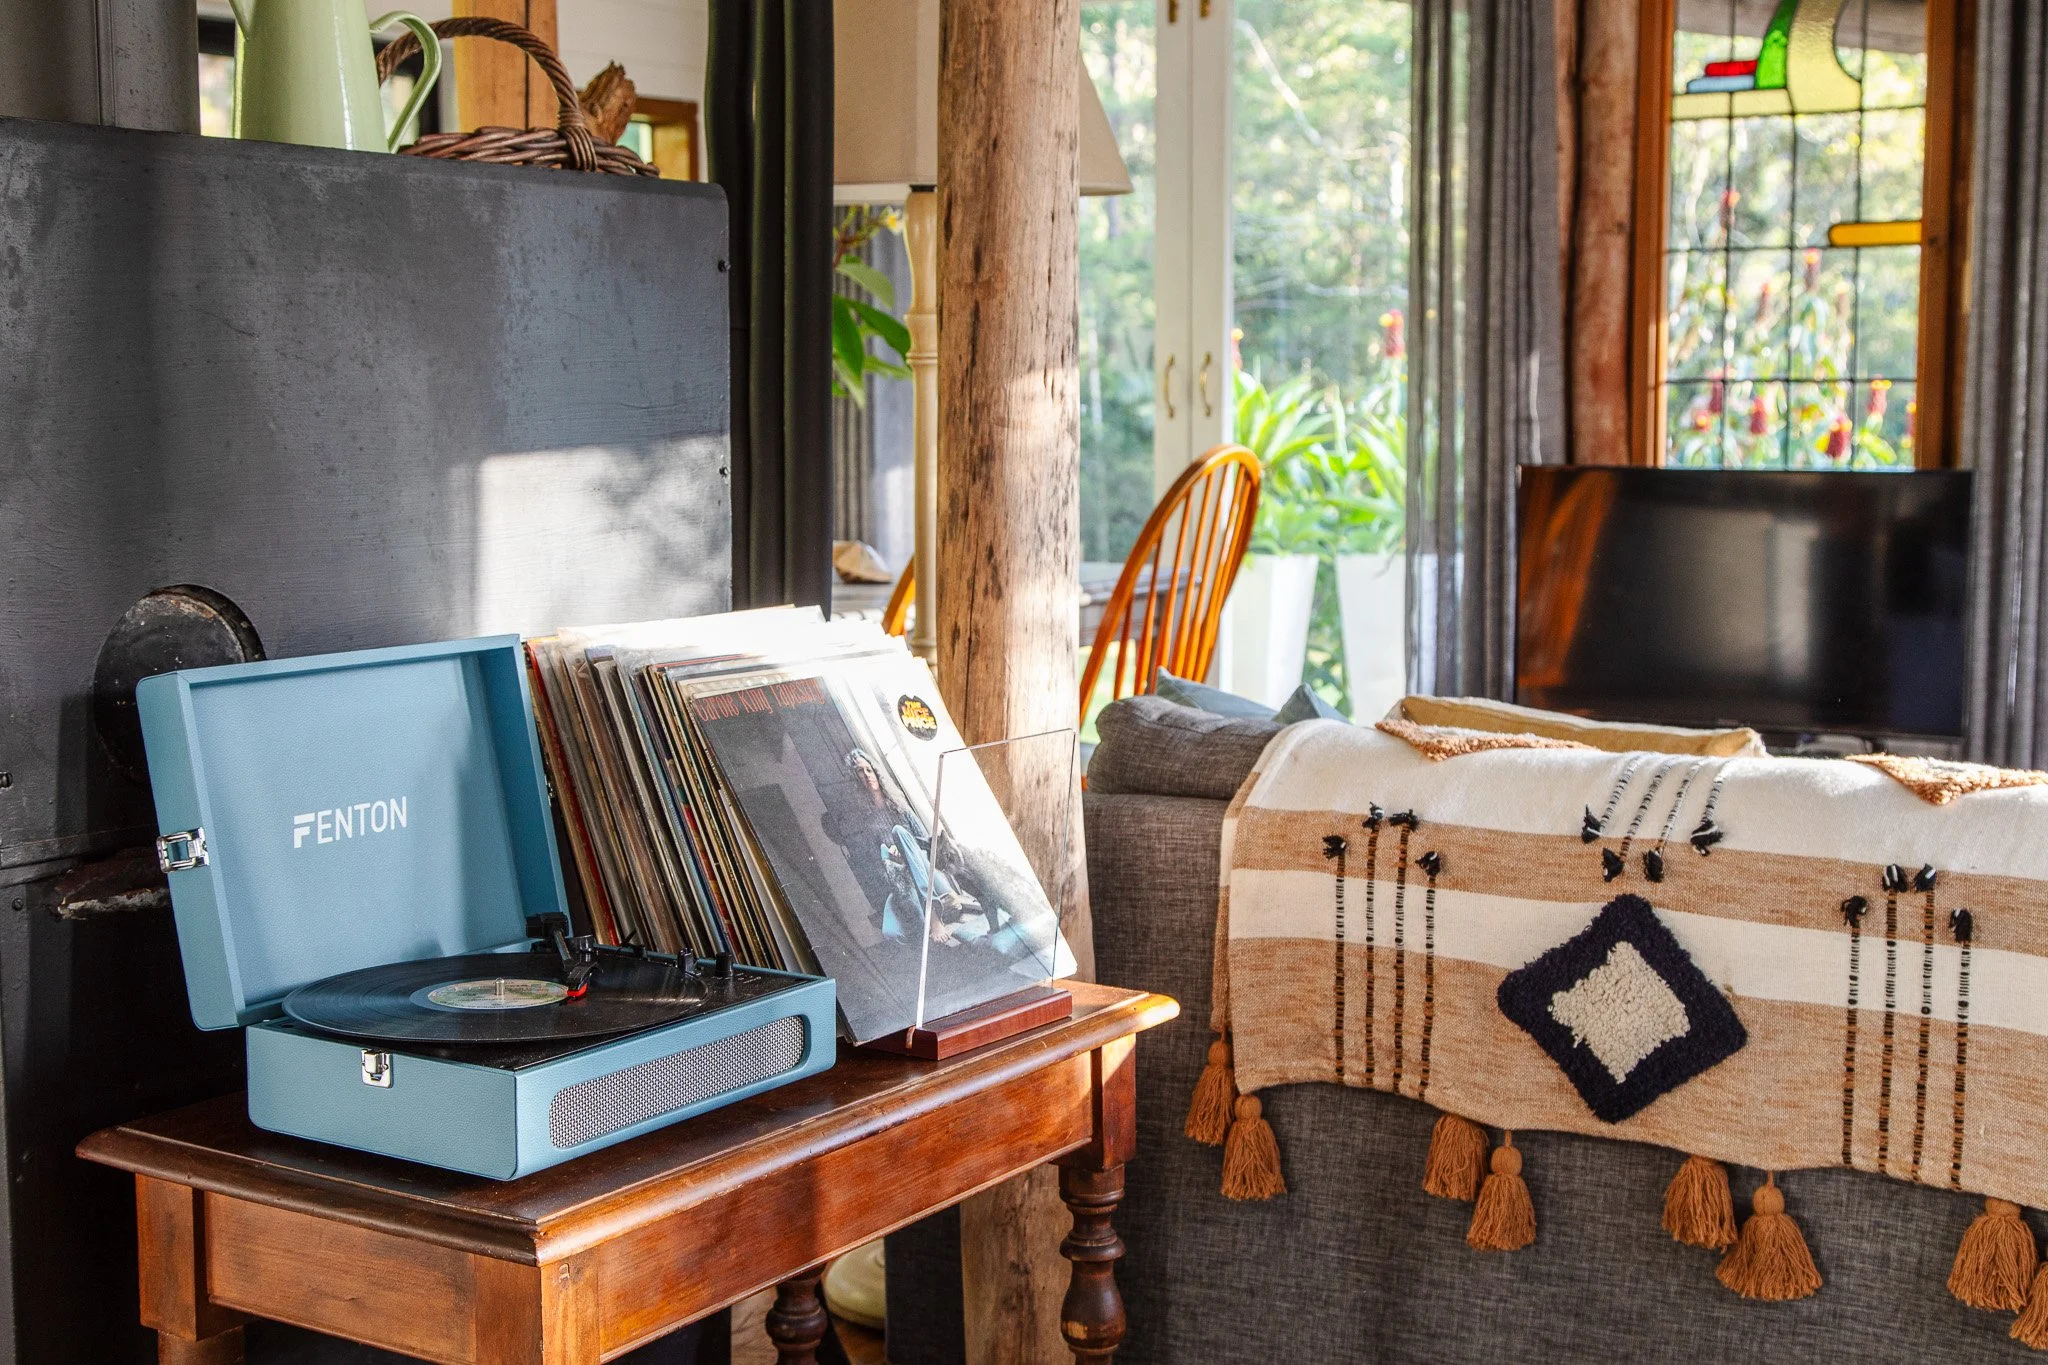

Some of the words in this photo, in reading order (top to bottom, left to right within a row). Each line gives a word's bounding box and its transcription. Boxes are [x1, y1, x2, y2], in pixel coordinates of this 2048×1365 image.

[695, 696, 740, 722] Carole
[738, 687, 773, 715] King
[770, 678, 825, 708] Tapestry
[293, 796, 407, 849] FENTON
